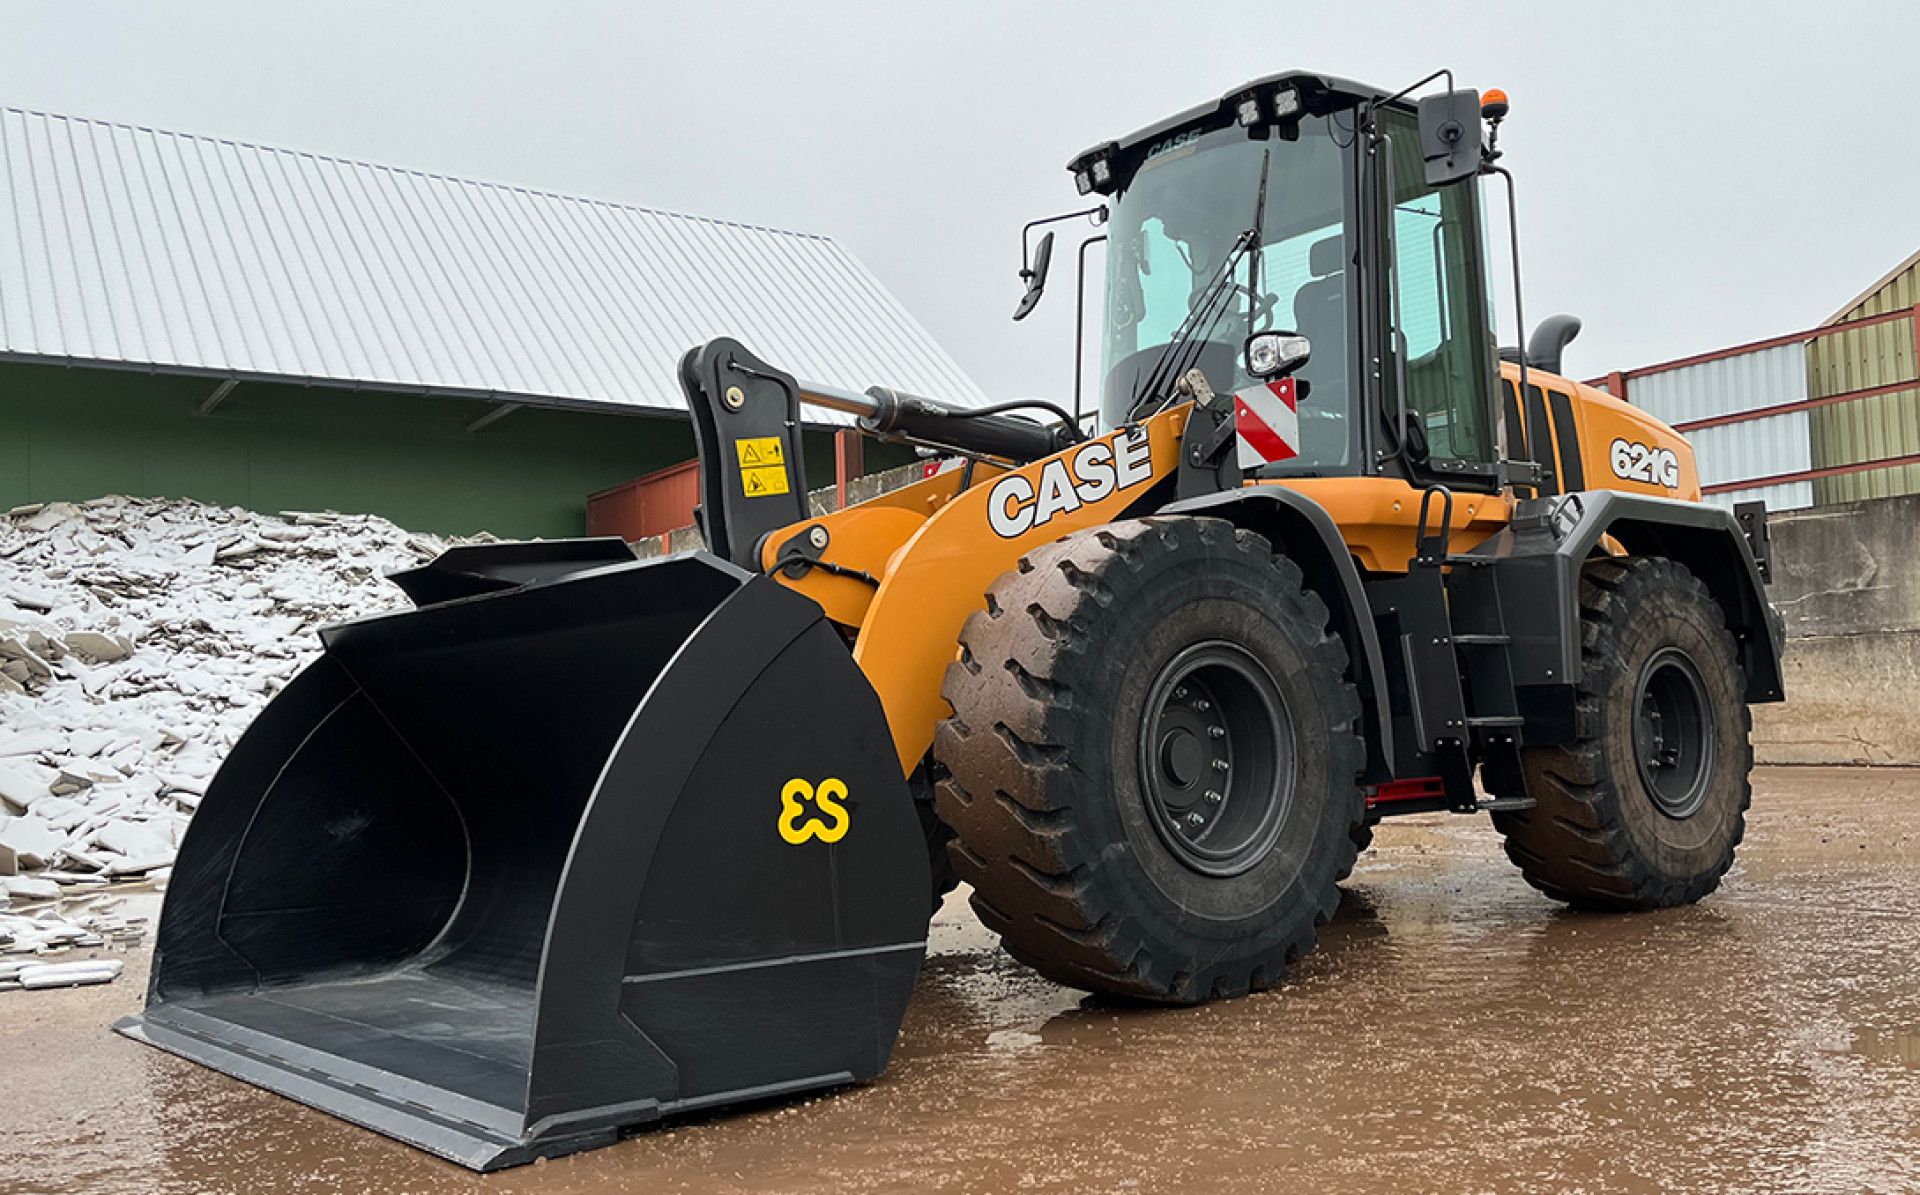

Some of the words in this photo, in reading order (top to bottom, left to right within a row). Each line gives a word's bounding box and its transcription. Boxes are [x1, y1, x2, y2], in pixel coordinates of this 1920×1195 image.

[1147, 128, 1201, 160] CASE
[988, 423, 1153, 539] CASE
[1610, 437, 1678, 488] 621G
